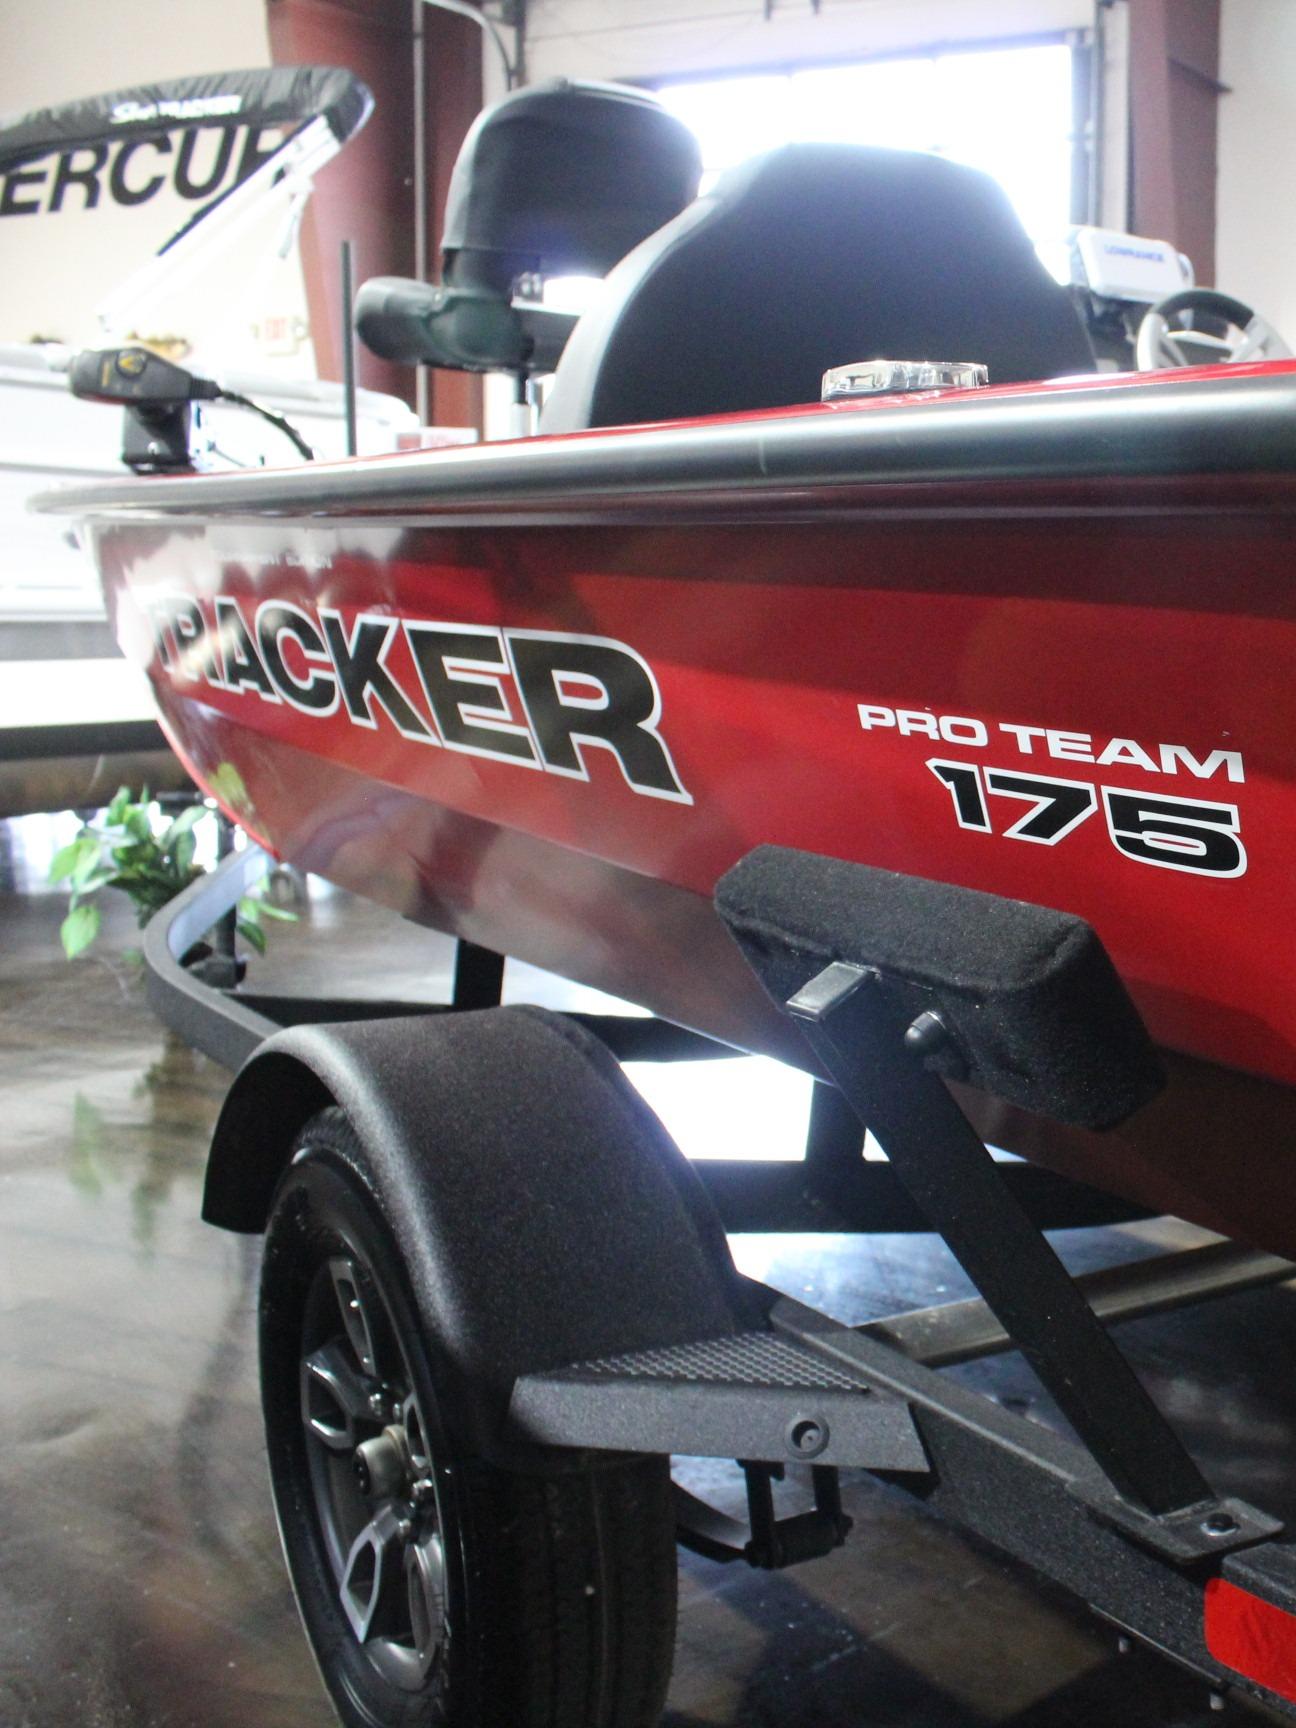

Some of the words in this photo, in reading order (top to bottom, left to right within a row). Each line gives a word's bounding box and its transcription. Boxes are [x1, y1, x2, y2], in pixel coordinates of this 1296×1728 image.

[857, 704, 988, 748] PRO
[999, 722, 1246, 783] TEAM
[925, 757, 1248, 879] 175
